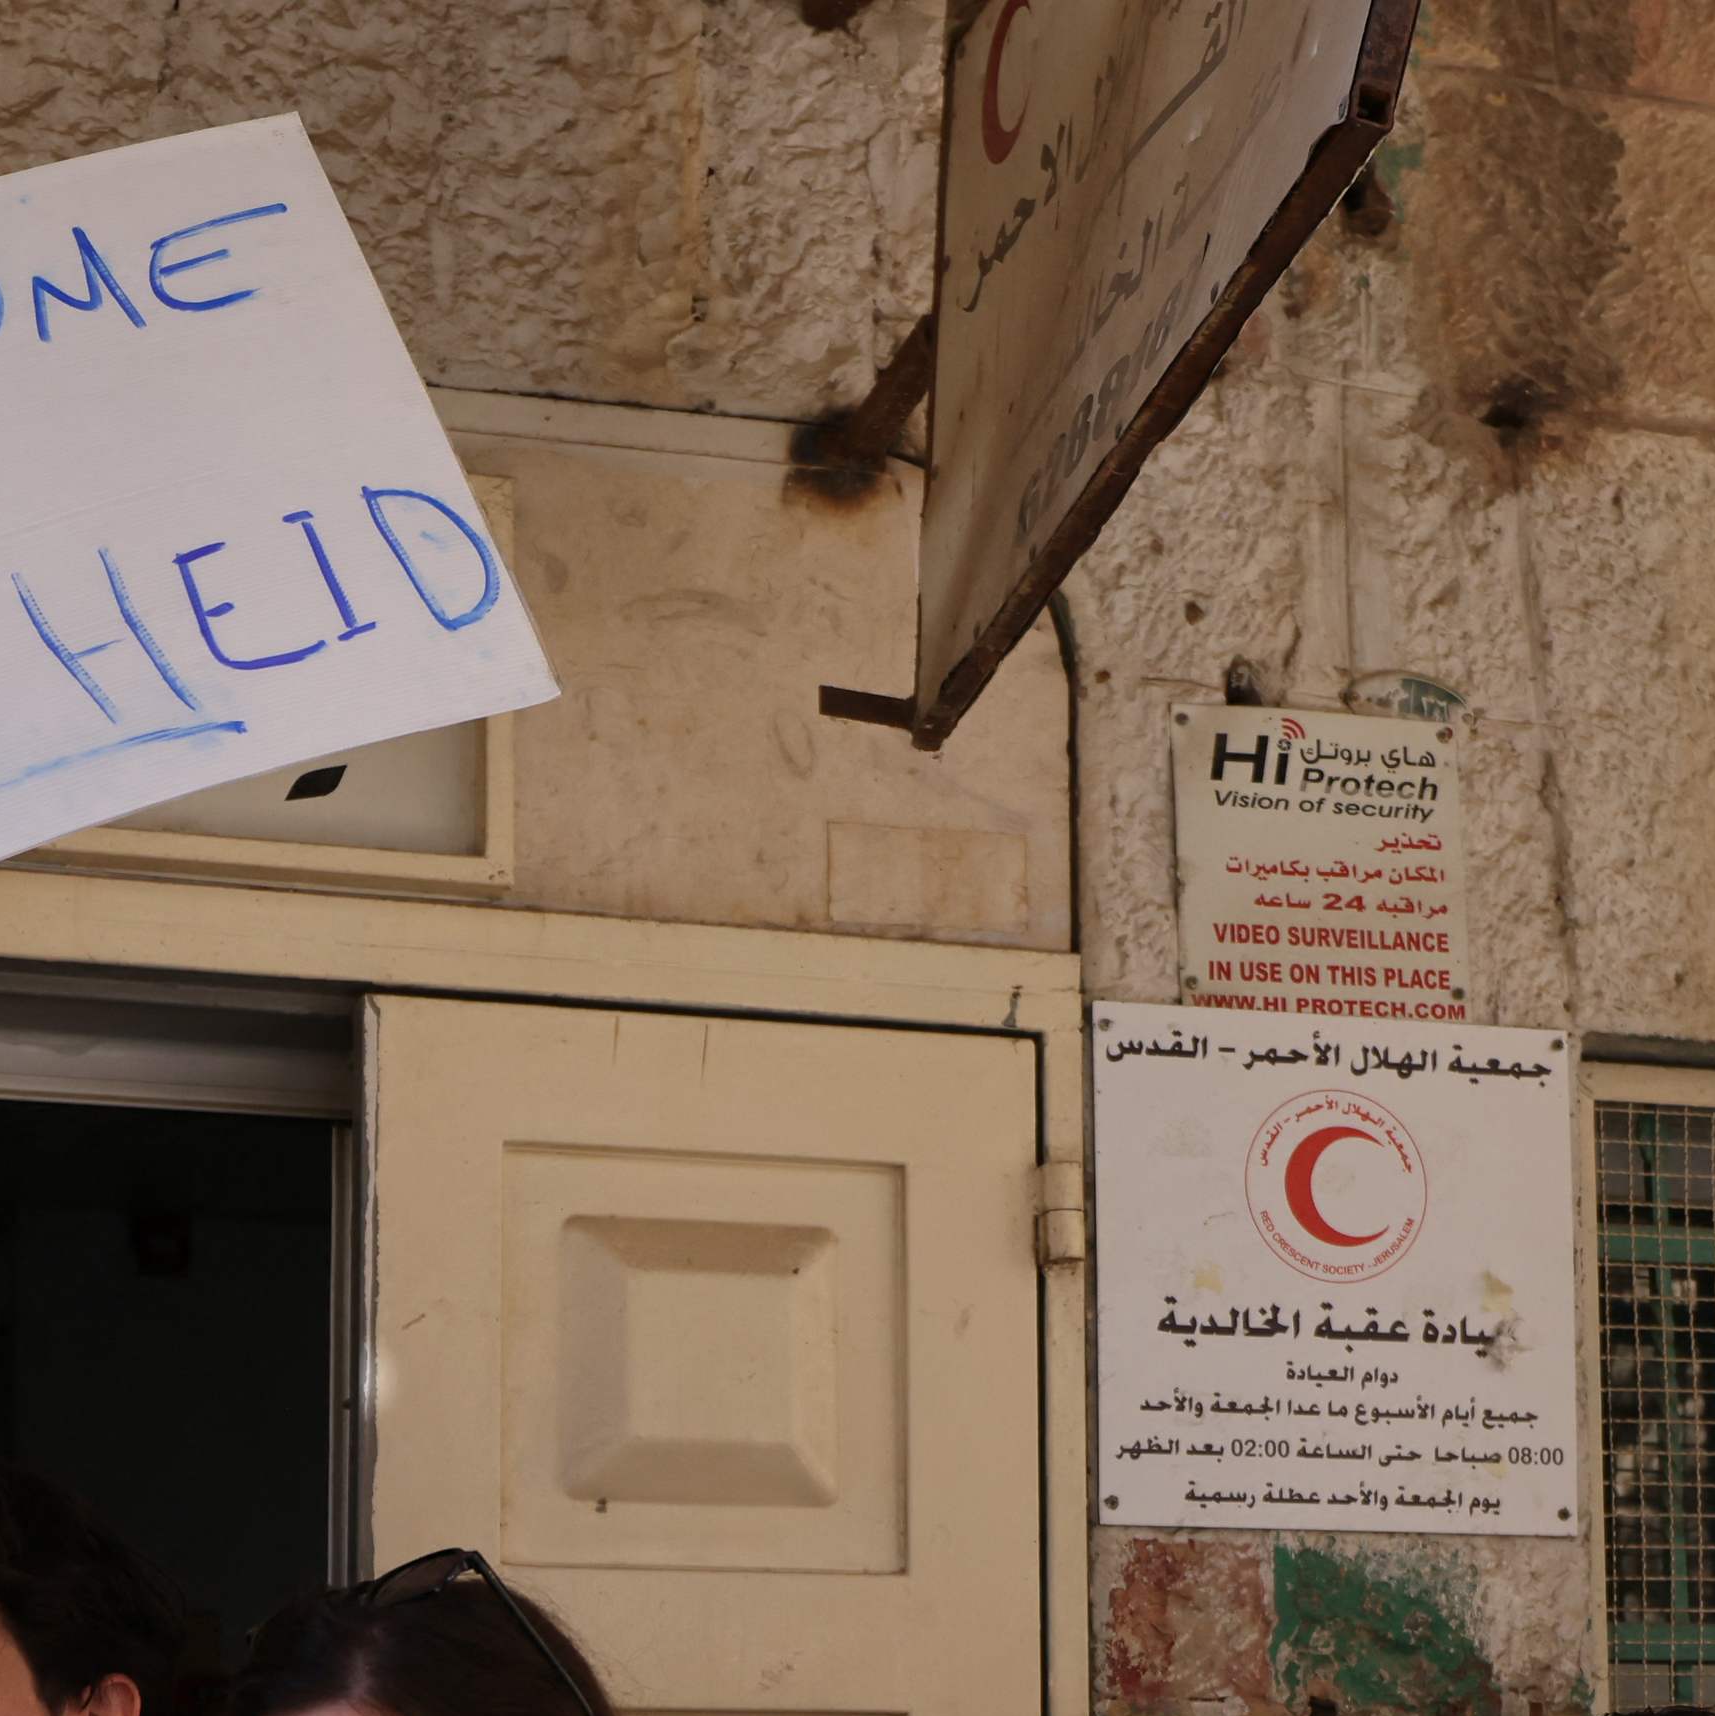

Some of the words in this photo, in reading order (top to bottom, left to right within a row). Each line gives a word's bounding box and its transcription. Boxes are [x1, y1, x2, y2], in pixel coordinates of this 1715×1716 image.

[1210, 732, 1292, 786] Hi
[1300, 767, 1439, 802] Protech
[1214, 789, 1289, 812] Vision
[1299, 797, 1326, 814] of
[1332, 799, 1434, 824] security
[1374, 832, 1443, 854] تحذير
[1225, 856, 1310, 883] بكاميرات
[1316, 860, 1382, 883] مراقب
[1388, 866, 1445, 886] المكان
[1322, 893, 1366, 913] 24
[1213, 922, 1281, 945] VIDEO
[1287, 926, 1450, 953] SURVEILLANCE
[1208, 960, 1232, 982] IN
[1240, 961, 1282, 984] USE
[1290, 963, 1320, 985] ON
[1327, 964, 1377, 987] THIS
[1384, 967, 1451, 991] PLACE
[1105, 1030, 1209, 1062] القدس
[1242, 1030, 1341, 1071] الأحمر
[1350, 1045, 1438, 1080] الهلال
[1447, 1043, 1552, 1089] جمعية
[1341, 1102, 1386, 1128] الهلال
[1385, 1125, 1413, 1174] جمعية
[1260, 1209, 1275, 1233] RED
[1272, 1232, 1321, 1271] CRESCENT
[1322, 1262, 1365, 1275] SOCIETY
[1372, 1217, 1415, 1268] JERUSALEM
[1157, 1295, 1300, 1348] الخالدية
[1314, 1302, 1411, 1353] عقبة
[1422, 1308, 1500, 1358] يادة
[1285, 1359, 1355, 1387] العيادة
[1360, 1368, 1399, 1388] دوام
[1140, 1387, 1204, 1419] والأحد
[1209, 1392, 1281, 1420] الجمعة
[1287, 1398, 1322, 1418] عدا
[1327, 1399, 1348, 1420] ما
[1354, 1392, 1435, 1426] الأسبوع
[1441, 1395, 1476, 1427] أيام
[1482, 1406, 1540, 1430] جميع
[1114, 1437, 1180, 1460] الظهر
[1186, 1440, 1225, 1462] بعد
[1230, 1439, 1291, 1459] 02:00
[1296, 1436, 1372, 1462] الساعة
[1379, 1443, 1423, 1467] حتى
[1434, 1444, 1502, 1468] صباحا
[1508, 1446, 1565, 1466] 08:00
[1184, 1479, 1257, 1509] رسمية
[1262, 1480, 1321, 1505] عطلة
[1326, 1479, 1389, 1509] والأحد
[1394, 1484, 1463, 1511] الجمعة
[1468, 1495, 1502, 1517] يوم
